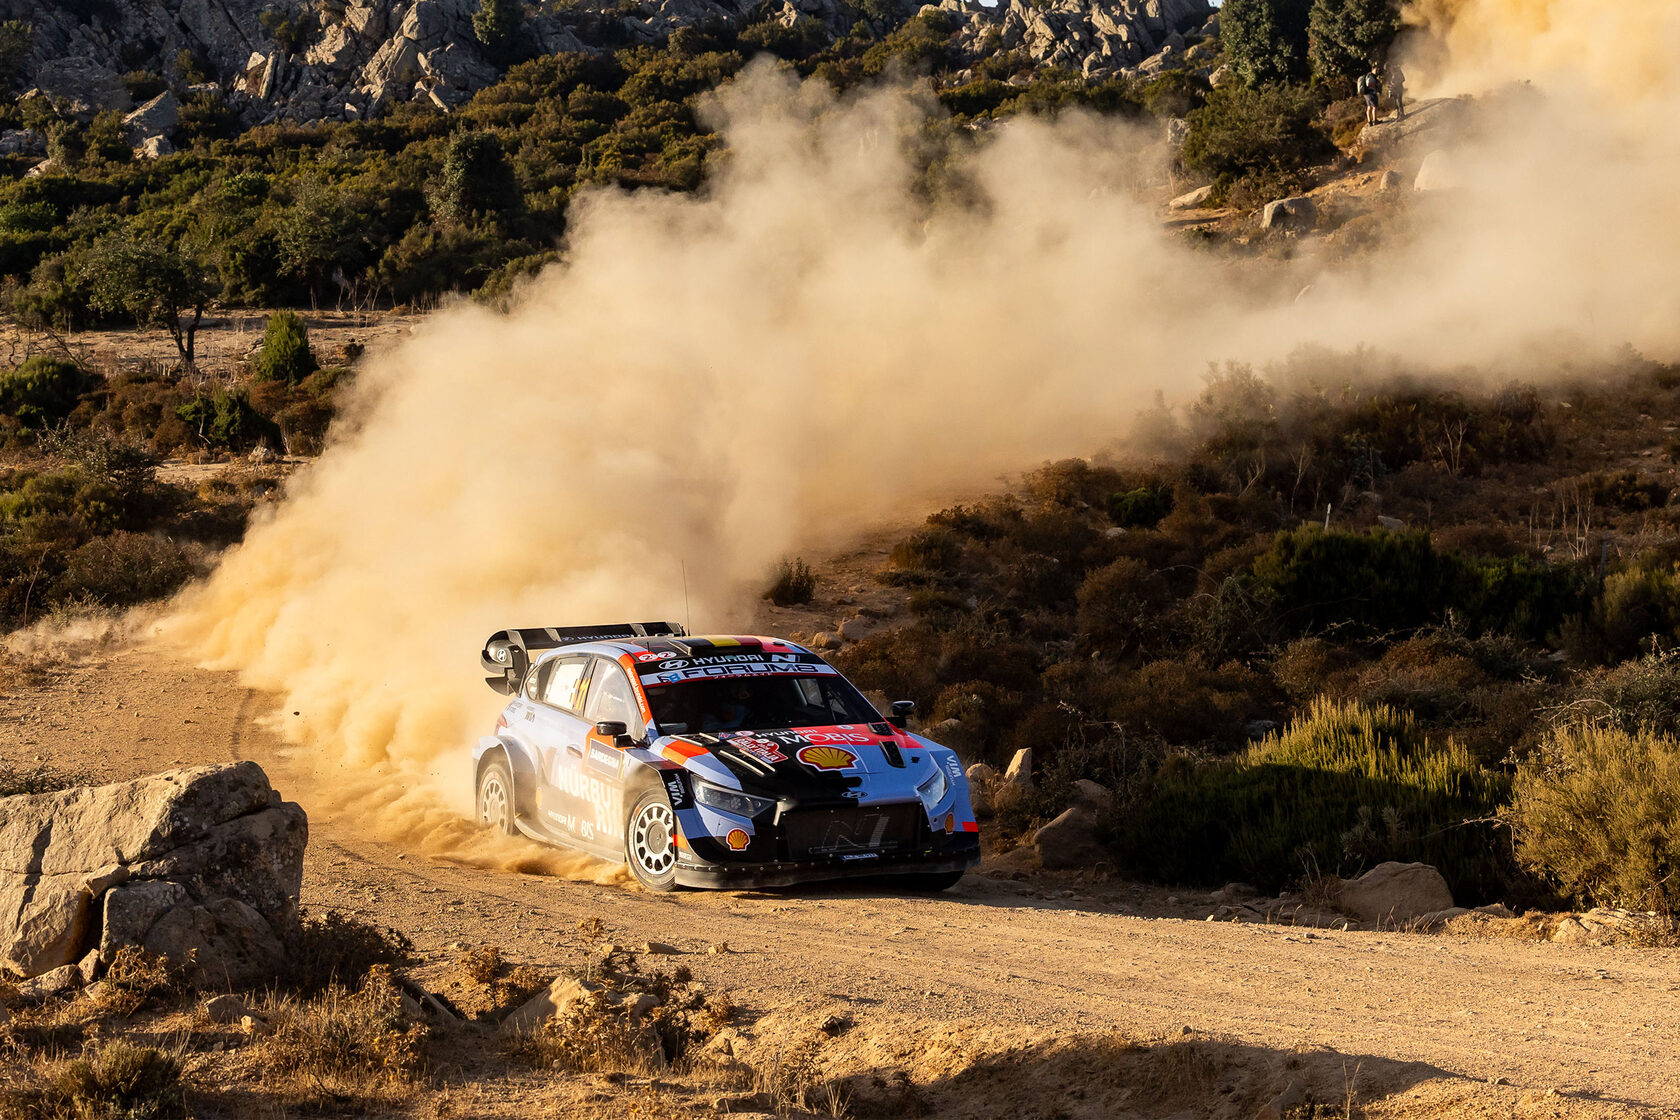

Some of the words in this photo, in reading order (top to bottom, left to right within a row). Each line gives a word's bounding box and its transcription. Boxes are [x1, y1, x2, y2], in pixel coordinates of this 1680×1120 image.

[693, 654, 764, 665] HYUNDAI
[755, 729, 819, 738] HYUNDAI
[778, 733, 870, 744] MOBIS
